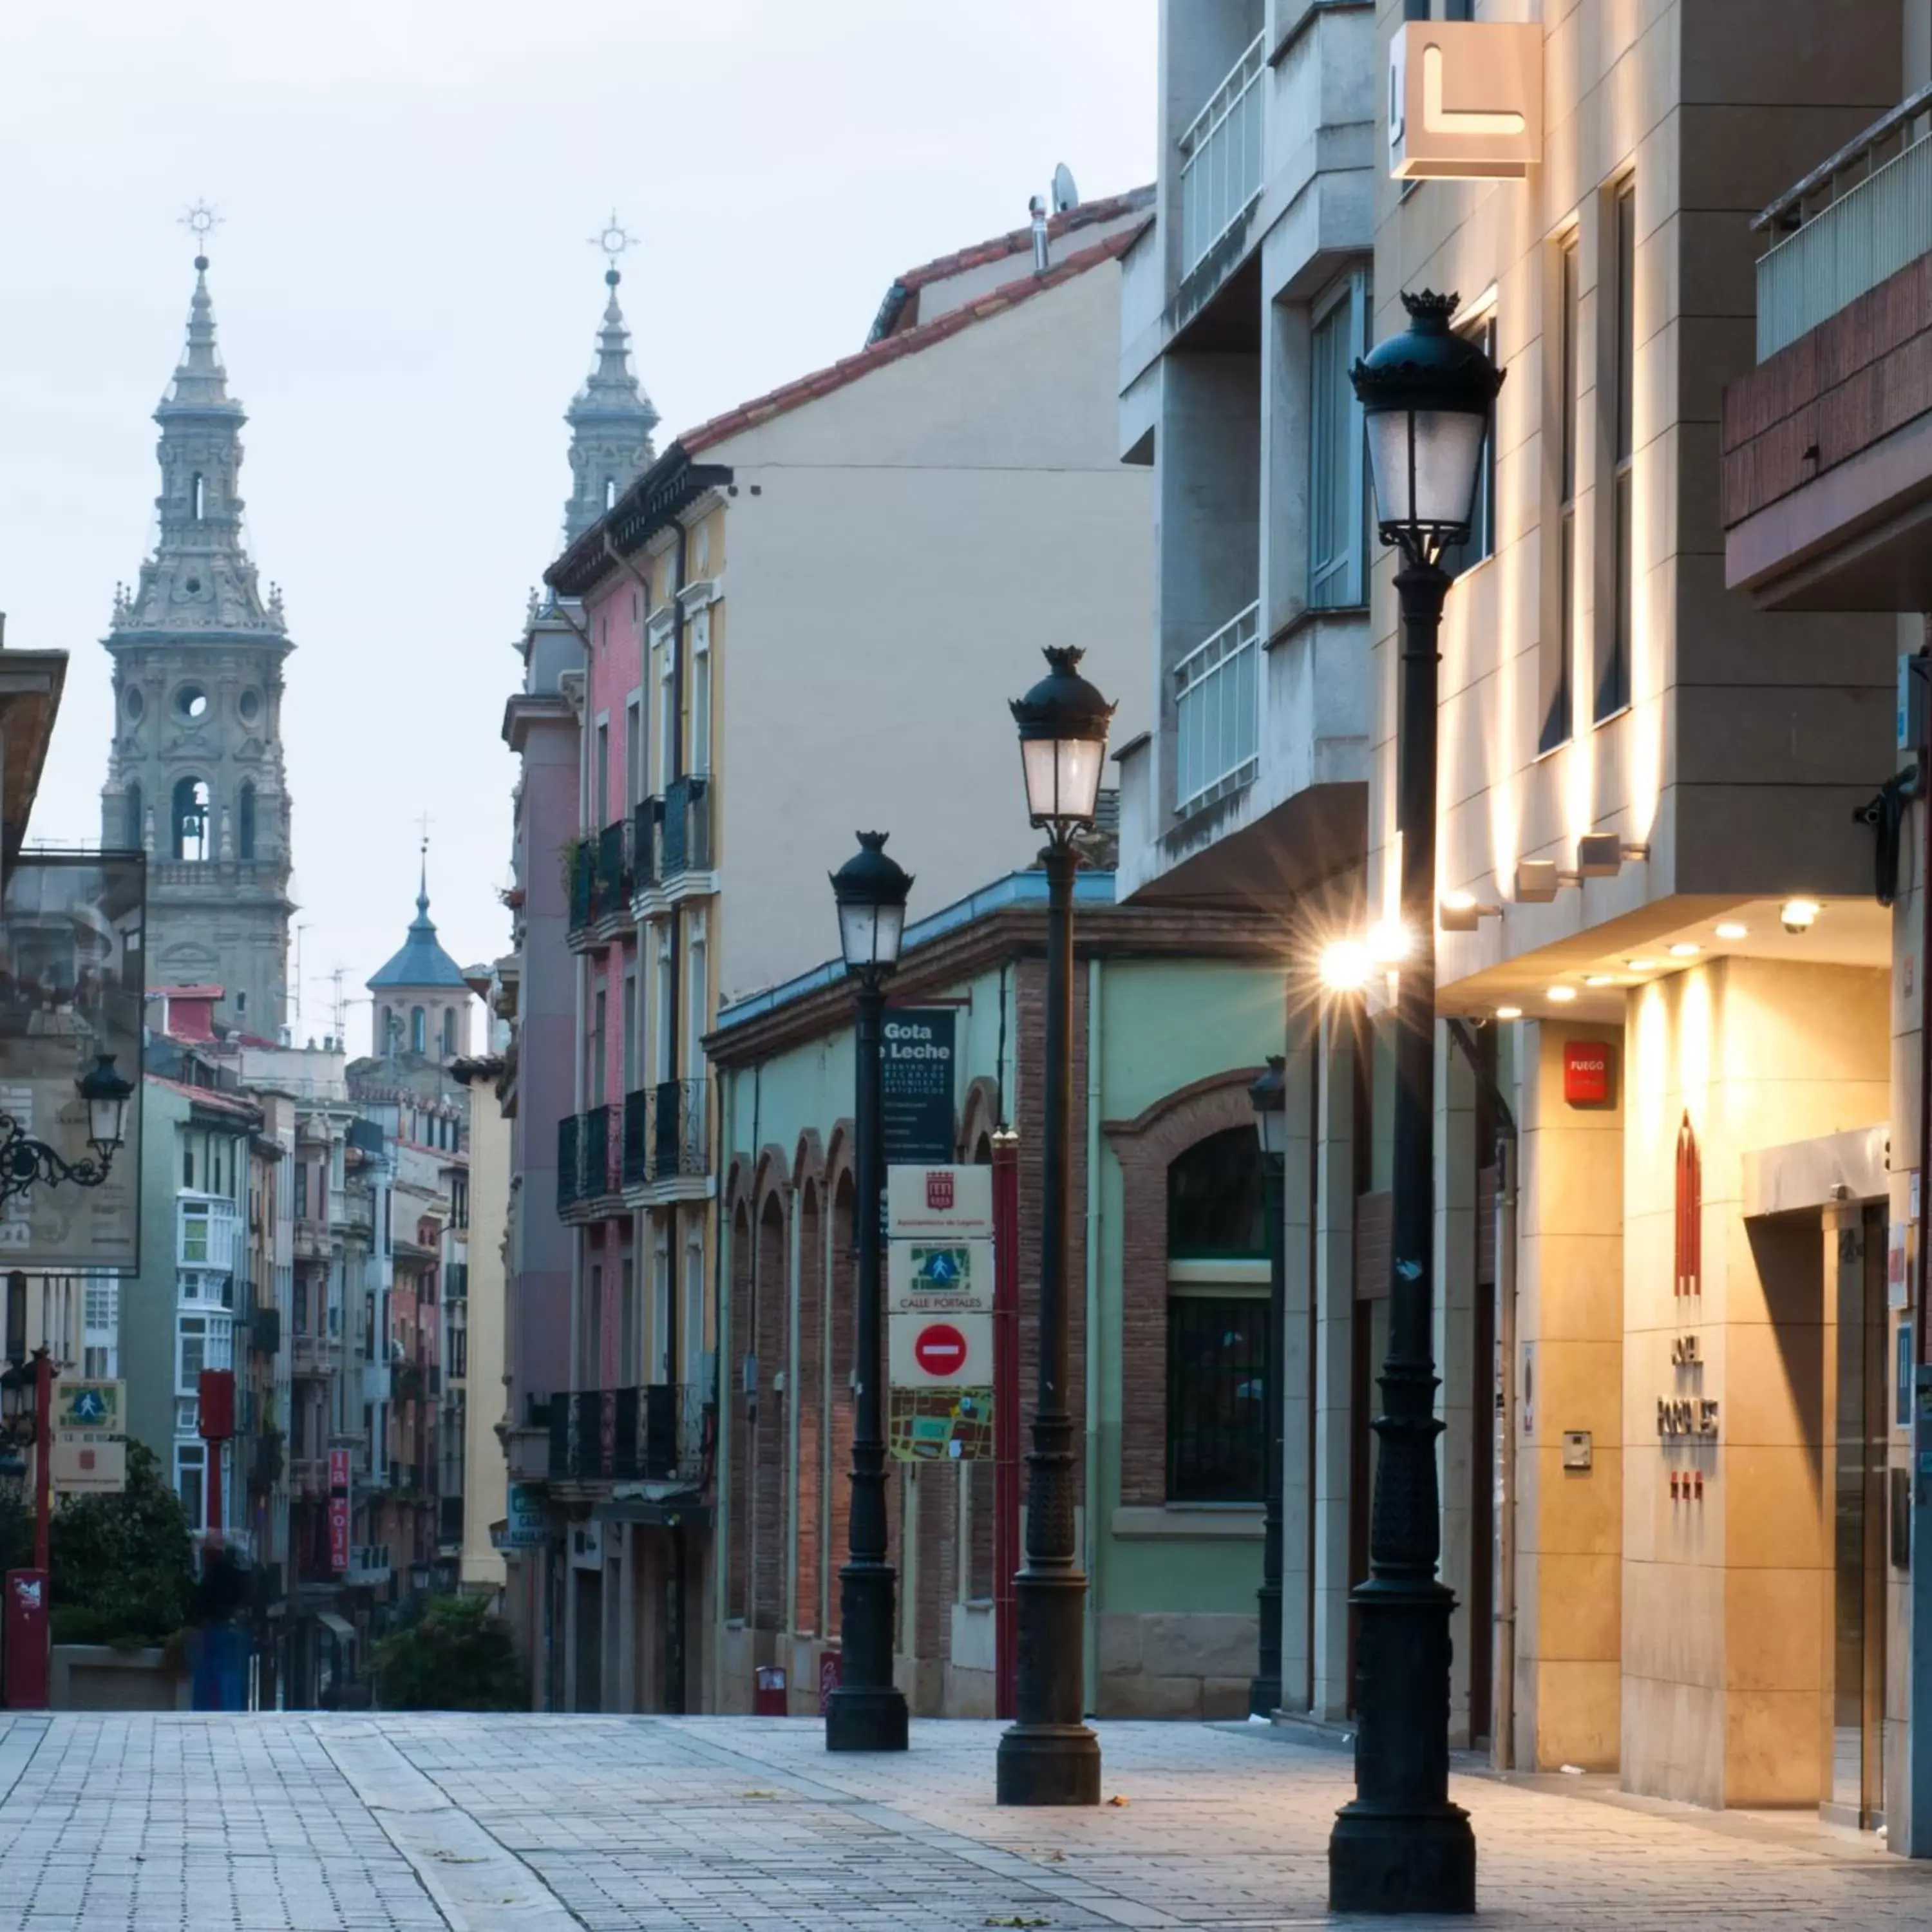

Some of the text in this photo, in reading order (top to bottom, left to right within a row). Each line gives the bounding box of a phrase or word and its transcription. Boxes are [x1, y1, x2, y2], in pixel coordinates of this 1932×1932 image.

[884, 1023, 932, 1039] Gota
[891, 1043, 951, 1059] Leche
[1571, 1061, 1604, 1070] FUEGO
[900, 1298, 981, 1308] CALLE PORTALES
[332, 1452, 346, 1483] la
[332, 1498, 346, 1567] roja
